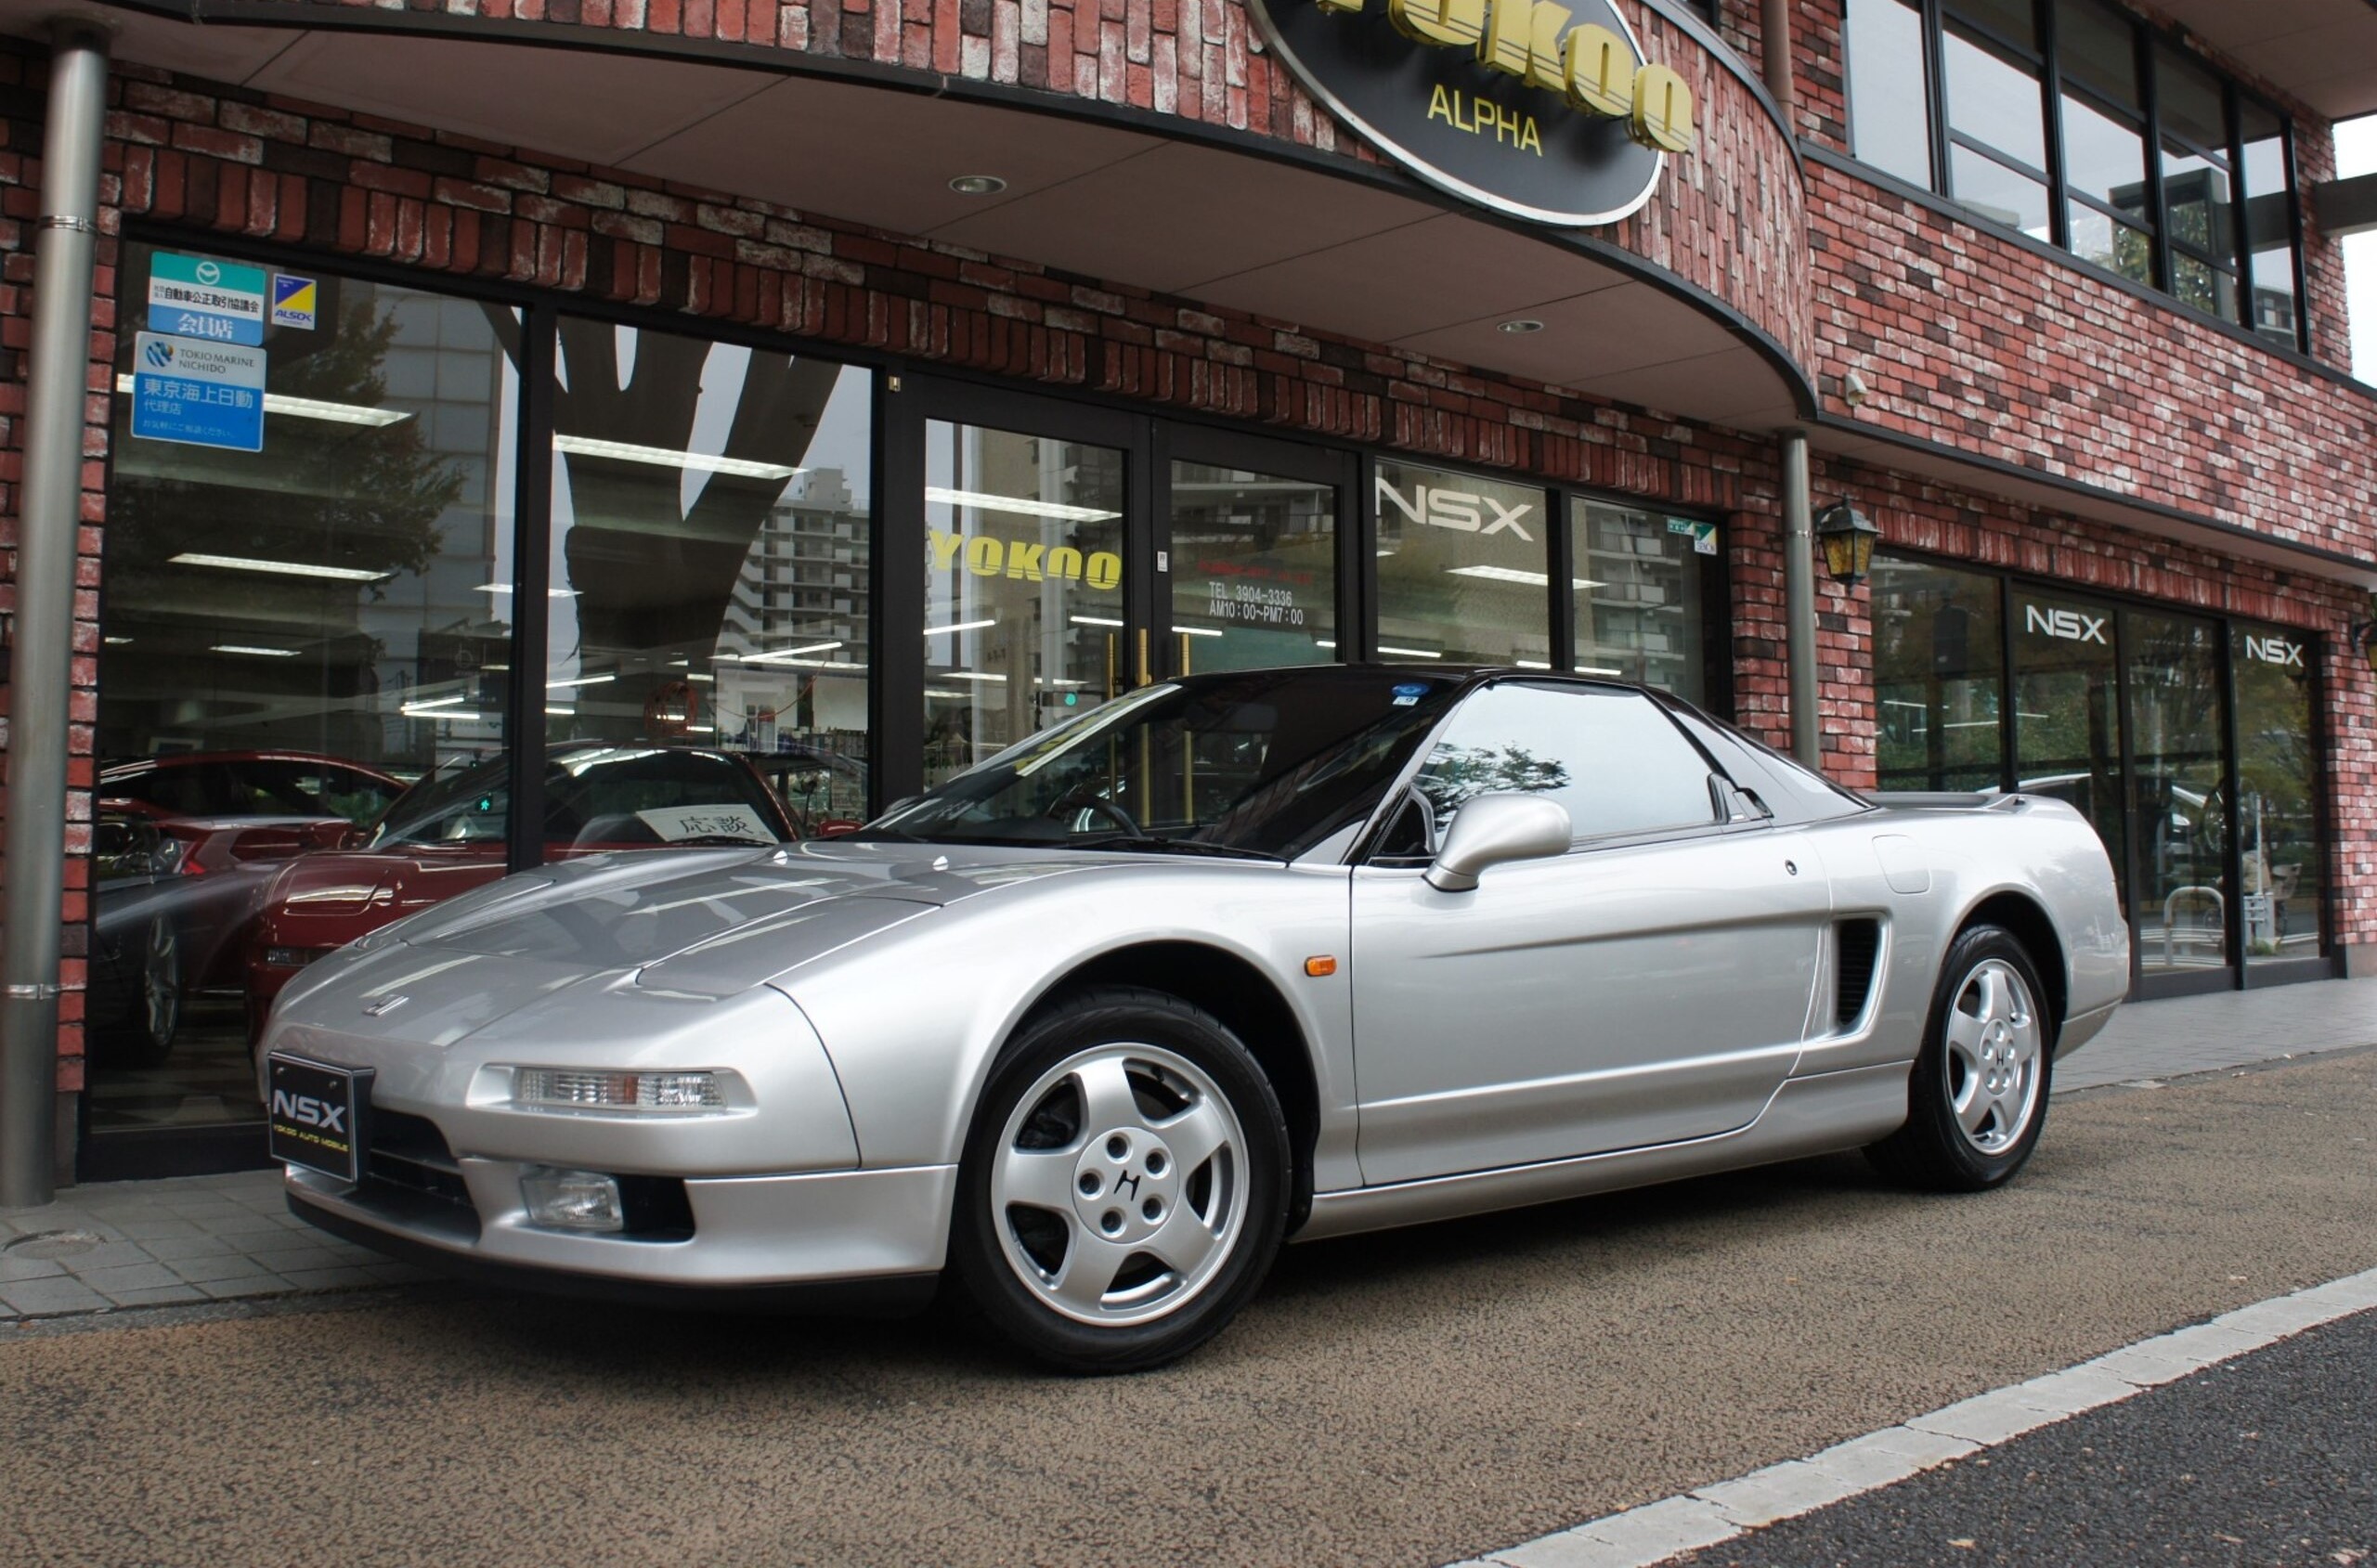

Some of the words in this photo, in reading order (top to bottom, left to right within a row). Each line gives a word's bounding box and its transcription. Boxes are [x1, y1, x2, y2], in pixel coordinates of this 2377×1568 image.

[1427, 84, 1542, 157] ALPHA
[178, 312, 234, 340] 会員店
[275, 309, 313, 322] ALSOK
[179, 360, 226, 374] NICHIDO
[180, 348, 213, 361] TOKIO
[214, 353, 255, 368] MARINE
[143, 377, 253, 409] 東京海上日動
[143, 398, 182, 416] 代理店
[1374, 476, 1535, 542] NSX
[929, 530, 1123, 590] YOKOO
[1209, 581, 1227, 600] TEL
[1236, 585, 1292, 607] 3904-3336
[2025, 604, 2107, 645] NSX
[2245, 635, 2305, 667] NSX
[273, 1089, 345, 1134] NSX
